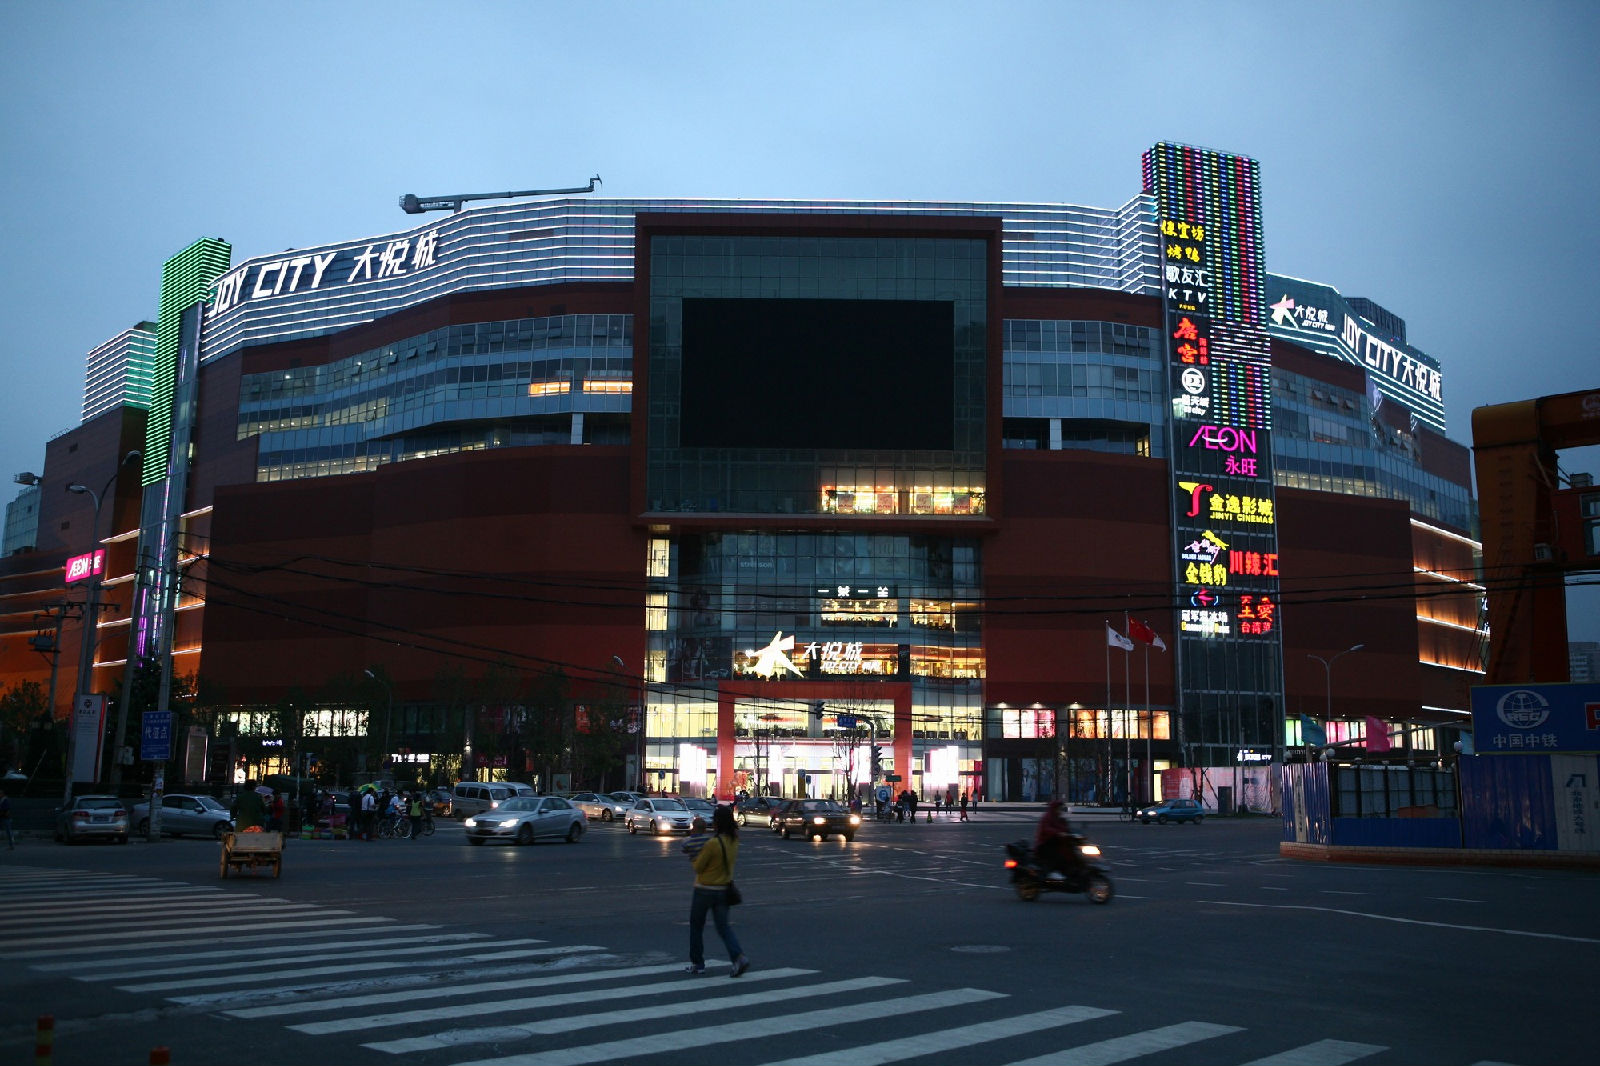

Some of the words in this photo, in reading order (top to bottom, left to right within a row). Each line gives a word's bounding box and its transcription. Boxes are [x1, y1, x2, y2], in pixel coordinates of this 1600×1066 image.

[1166, 244, 1201, 263] 烤鸭
[208, 267, 248, 318] JOY
[251, 252, 337, 299] CITY
[347, 229, 439, 283] 大悦城
[1168, 287, 1207, 303] KTV
[1293, 304, 1329, 324] 大悦城
[1341, 313, 1363, 355] JOY
[1365, 333, 1403, 378] CITY
[1401, 358, 1442, 402] 大悦城
[1225, 454, 1258, 477] 永旺
[1209, 493, 1273, 516] 金逸影城
[1236, 514, 1274, 525] CINEMAS
[1185, 561, 1227, 586] 金钱豹
[1229, 550, 1279, 576] 川辣汇
[802, 641, 864, 660] 大悦城
[1492, 733, 1559, 748] 中国中铁
